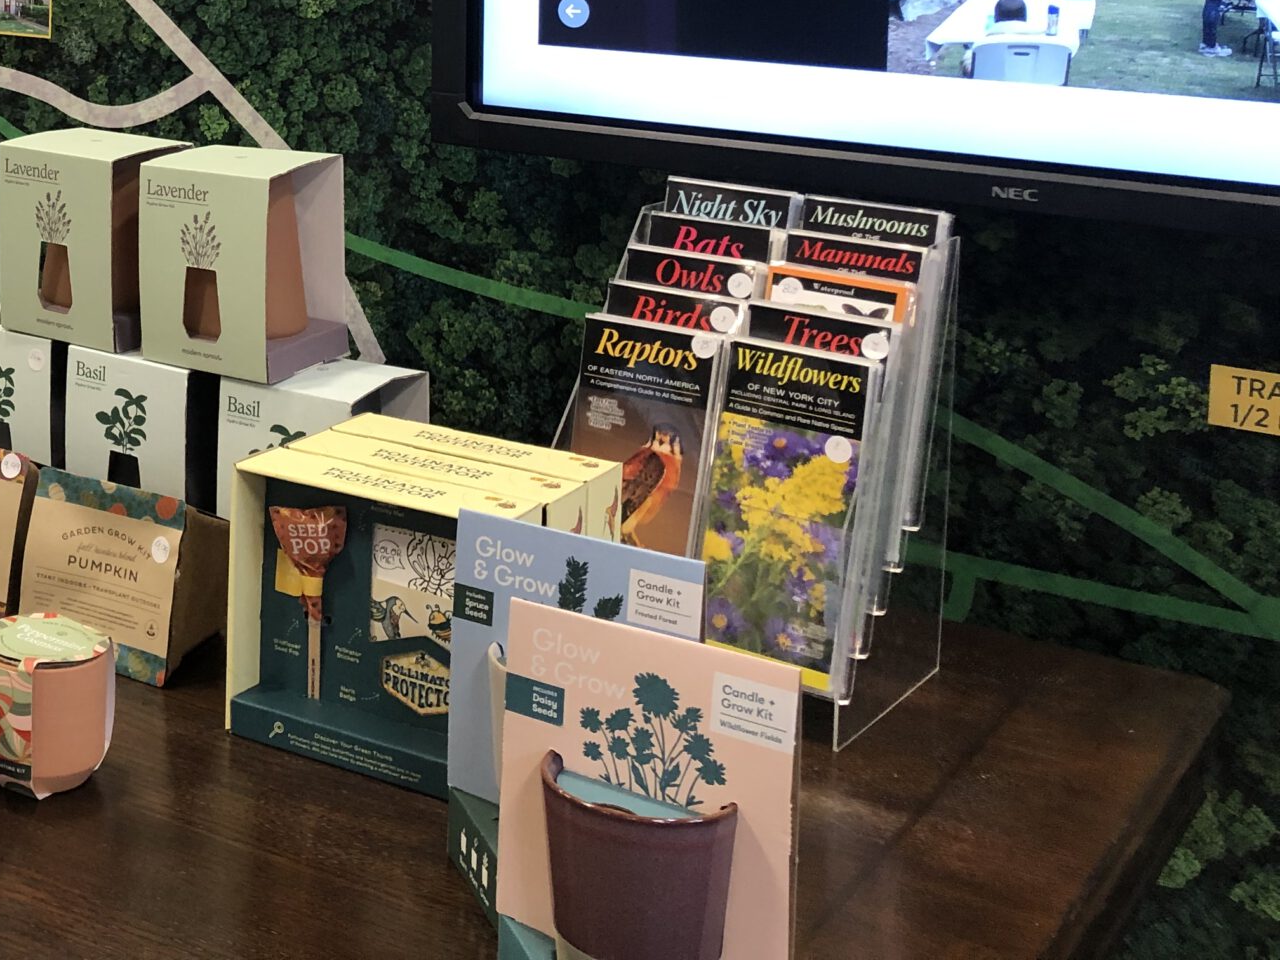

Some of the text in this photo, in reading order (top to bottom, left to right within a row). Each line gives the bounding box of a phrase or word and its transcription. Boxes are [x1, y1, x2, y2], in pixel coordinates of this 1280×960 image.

[4, 158, 60, 181] Lavender
[146, 179, 209, 202] Lavender
[991, 186, 1039, 202] NEC
[672, 189, 783, 227] Night Sky
[809, 205, 930, 237] Mushrooms
[673, 225, 745, 259] Bats
[795, 239, 916, 274] Mammals
[655, 258, 725, 293] Owls
[813, 282, 856, 296] Waterproof
[631, 294, 712, 332] Birds
[783, 314, 862, 357] Trees
[594, 327, 698, 371] Raptors
[76, 360, 106, 382] Basil
[587, 364, 700, 390] OF EASTERN NORTH AMERICA
[737, 347, 862, 393] Wildflowers
[747, 382, 840, 408] OF NEW YORK CITY
[1232, 375, 1280, 400] TRA
[227, 395, 260, 418] Basil
[1230, 404, 1270, 428] 1/2
[414, 433, 524, 459] PROTECTOR
[419, 430, 533, 456] POLLINATOR
[371, 452, 483, 480] PROTECTOR
[376, 448, 493, 477] POLLINATOR
[322, 471, 435, 499] PROTECTOR
[328, 467, 447, 496] POLLINATOR
[61, 526, 105, 540] GARDEN
[107, 528, 136, 546] GROW
[137, 544, 152, 560] KIT
[288, 523, 328, 537] SEED
[291, 537, 331, 555] POP
[373, 544, 401, 557] COLOR
[475, 535, 535, 568] Glow
[67, 555, 138, 583] PUMPKIN
[473, 559, 557, 598] & Grow
[636, 590, 681, 608] Grow Kit
[637, 578, 673, 595] Candle
[465, 598, 489, 611] Spruce
[465, 607, 487, 619] Seeds
[532, 628, 600, 664] Glow
[531, 654, 626, 699] & Grow
[532, 693, 558, 709] Daisy
[722, 684, 765, 705] Candle
[532, 703, 558, 718] Seeds
[721, 698, 774, 721] Grow Kit
[719, 719, 759, 737] Wildflower
